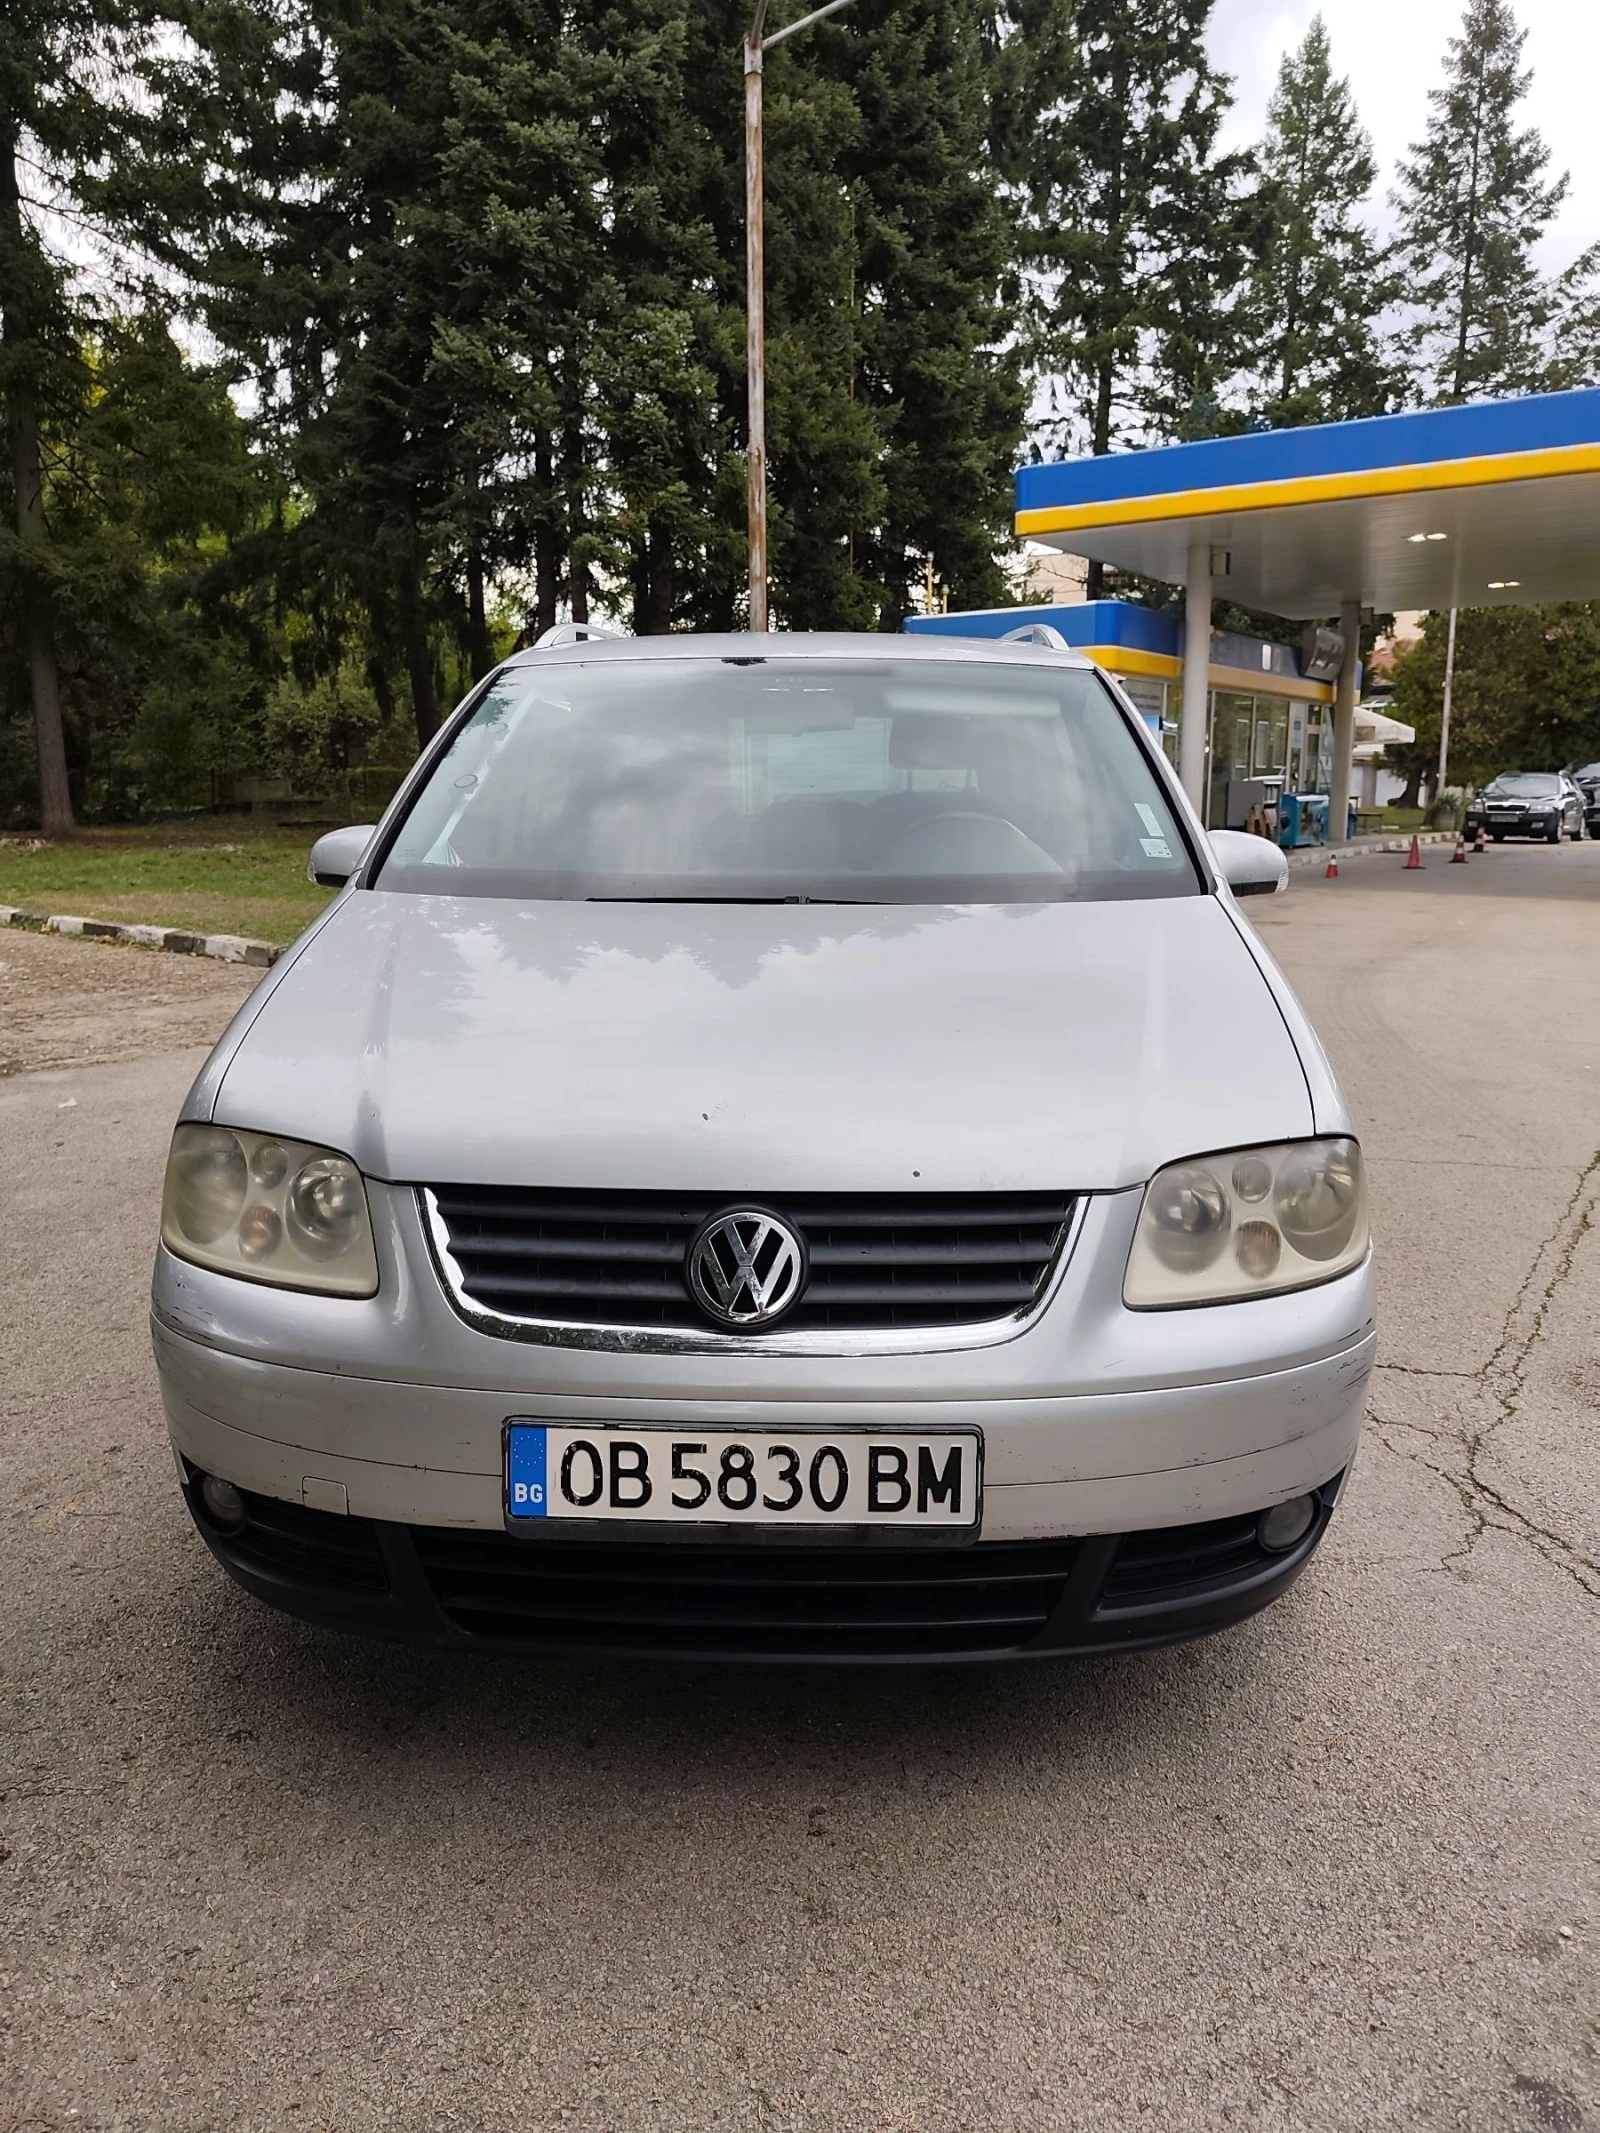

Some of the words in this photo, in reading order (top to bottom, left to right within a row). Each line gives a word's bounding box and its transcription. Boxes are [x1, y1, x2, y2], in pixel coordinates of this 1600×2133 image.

[691, 1212, 801, 1323] VW
[514, 1482, 544, 1504] BG
[560, 1440, 653, 1508] OB
[671, 1442, 849, 1512] 5830
[867, 1445, 963, 1513] BM
